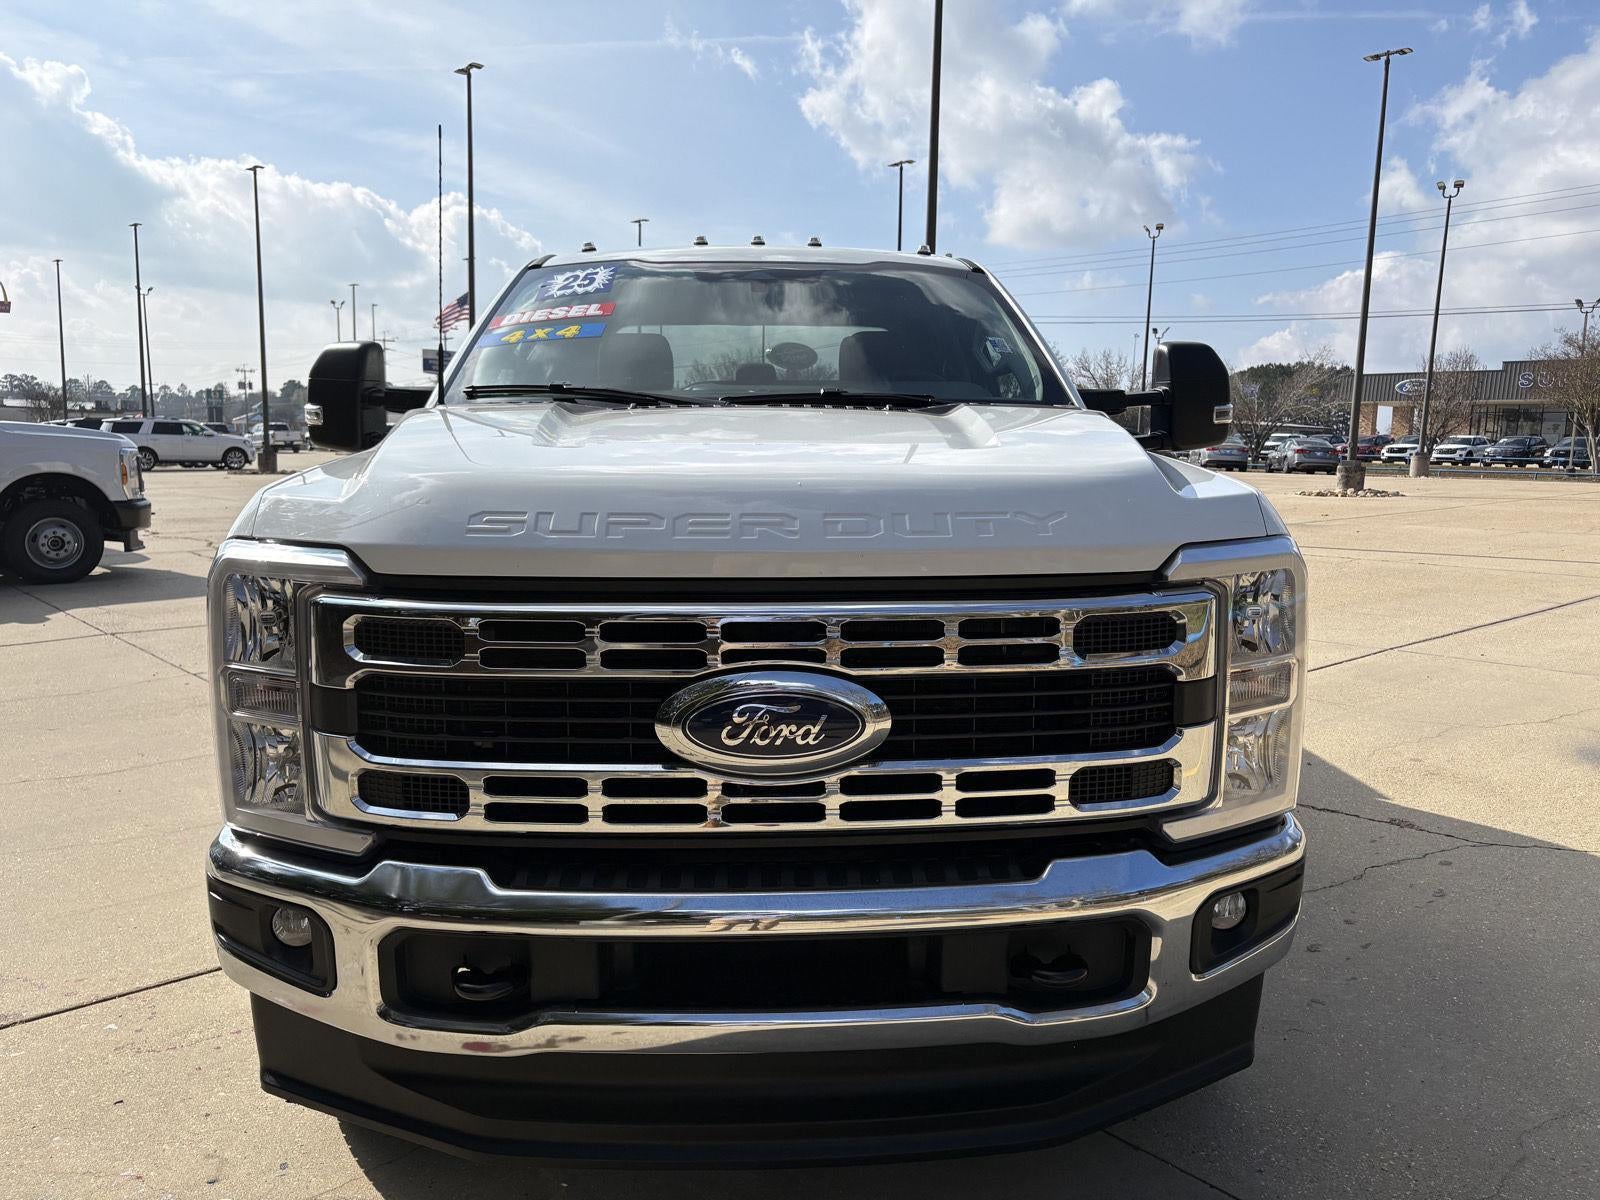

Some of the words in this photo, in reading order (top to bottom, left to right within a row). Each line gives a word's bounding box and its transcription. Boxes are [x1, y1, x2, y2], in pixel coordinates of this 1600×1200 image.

[559, 271, 600, 292] 25
[500, 303, 603, 327] DIESEL
[465, 510, 799, 540] SUPER
[822, 511, 1068, 539] DUTY
[721, 703, 828, 746] Ford
